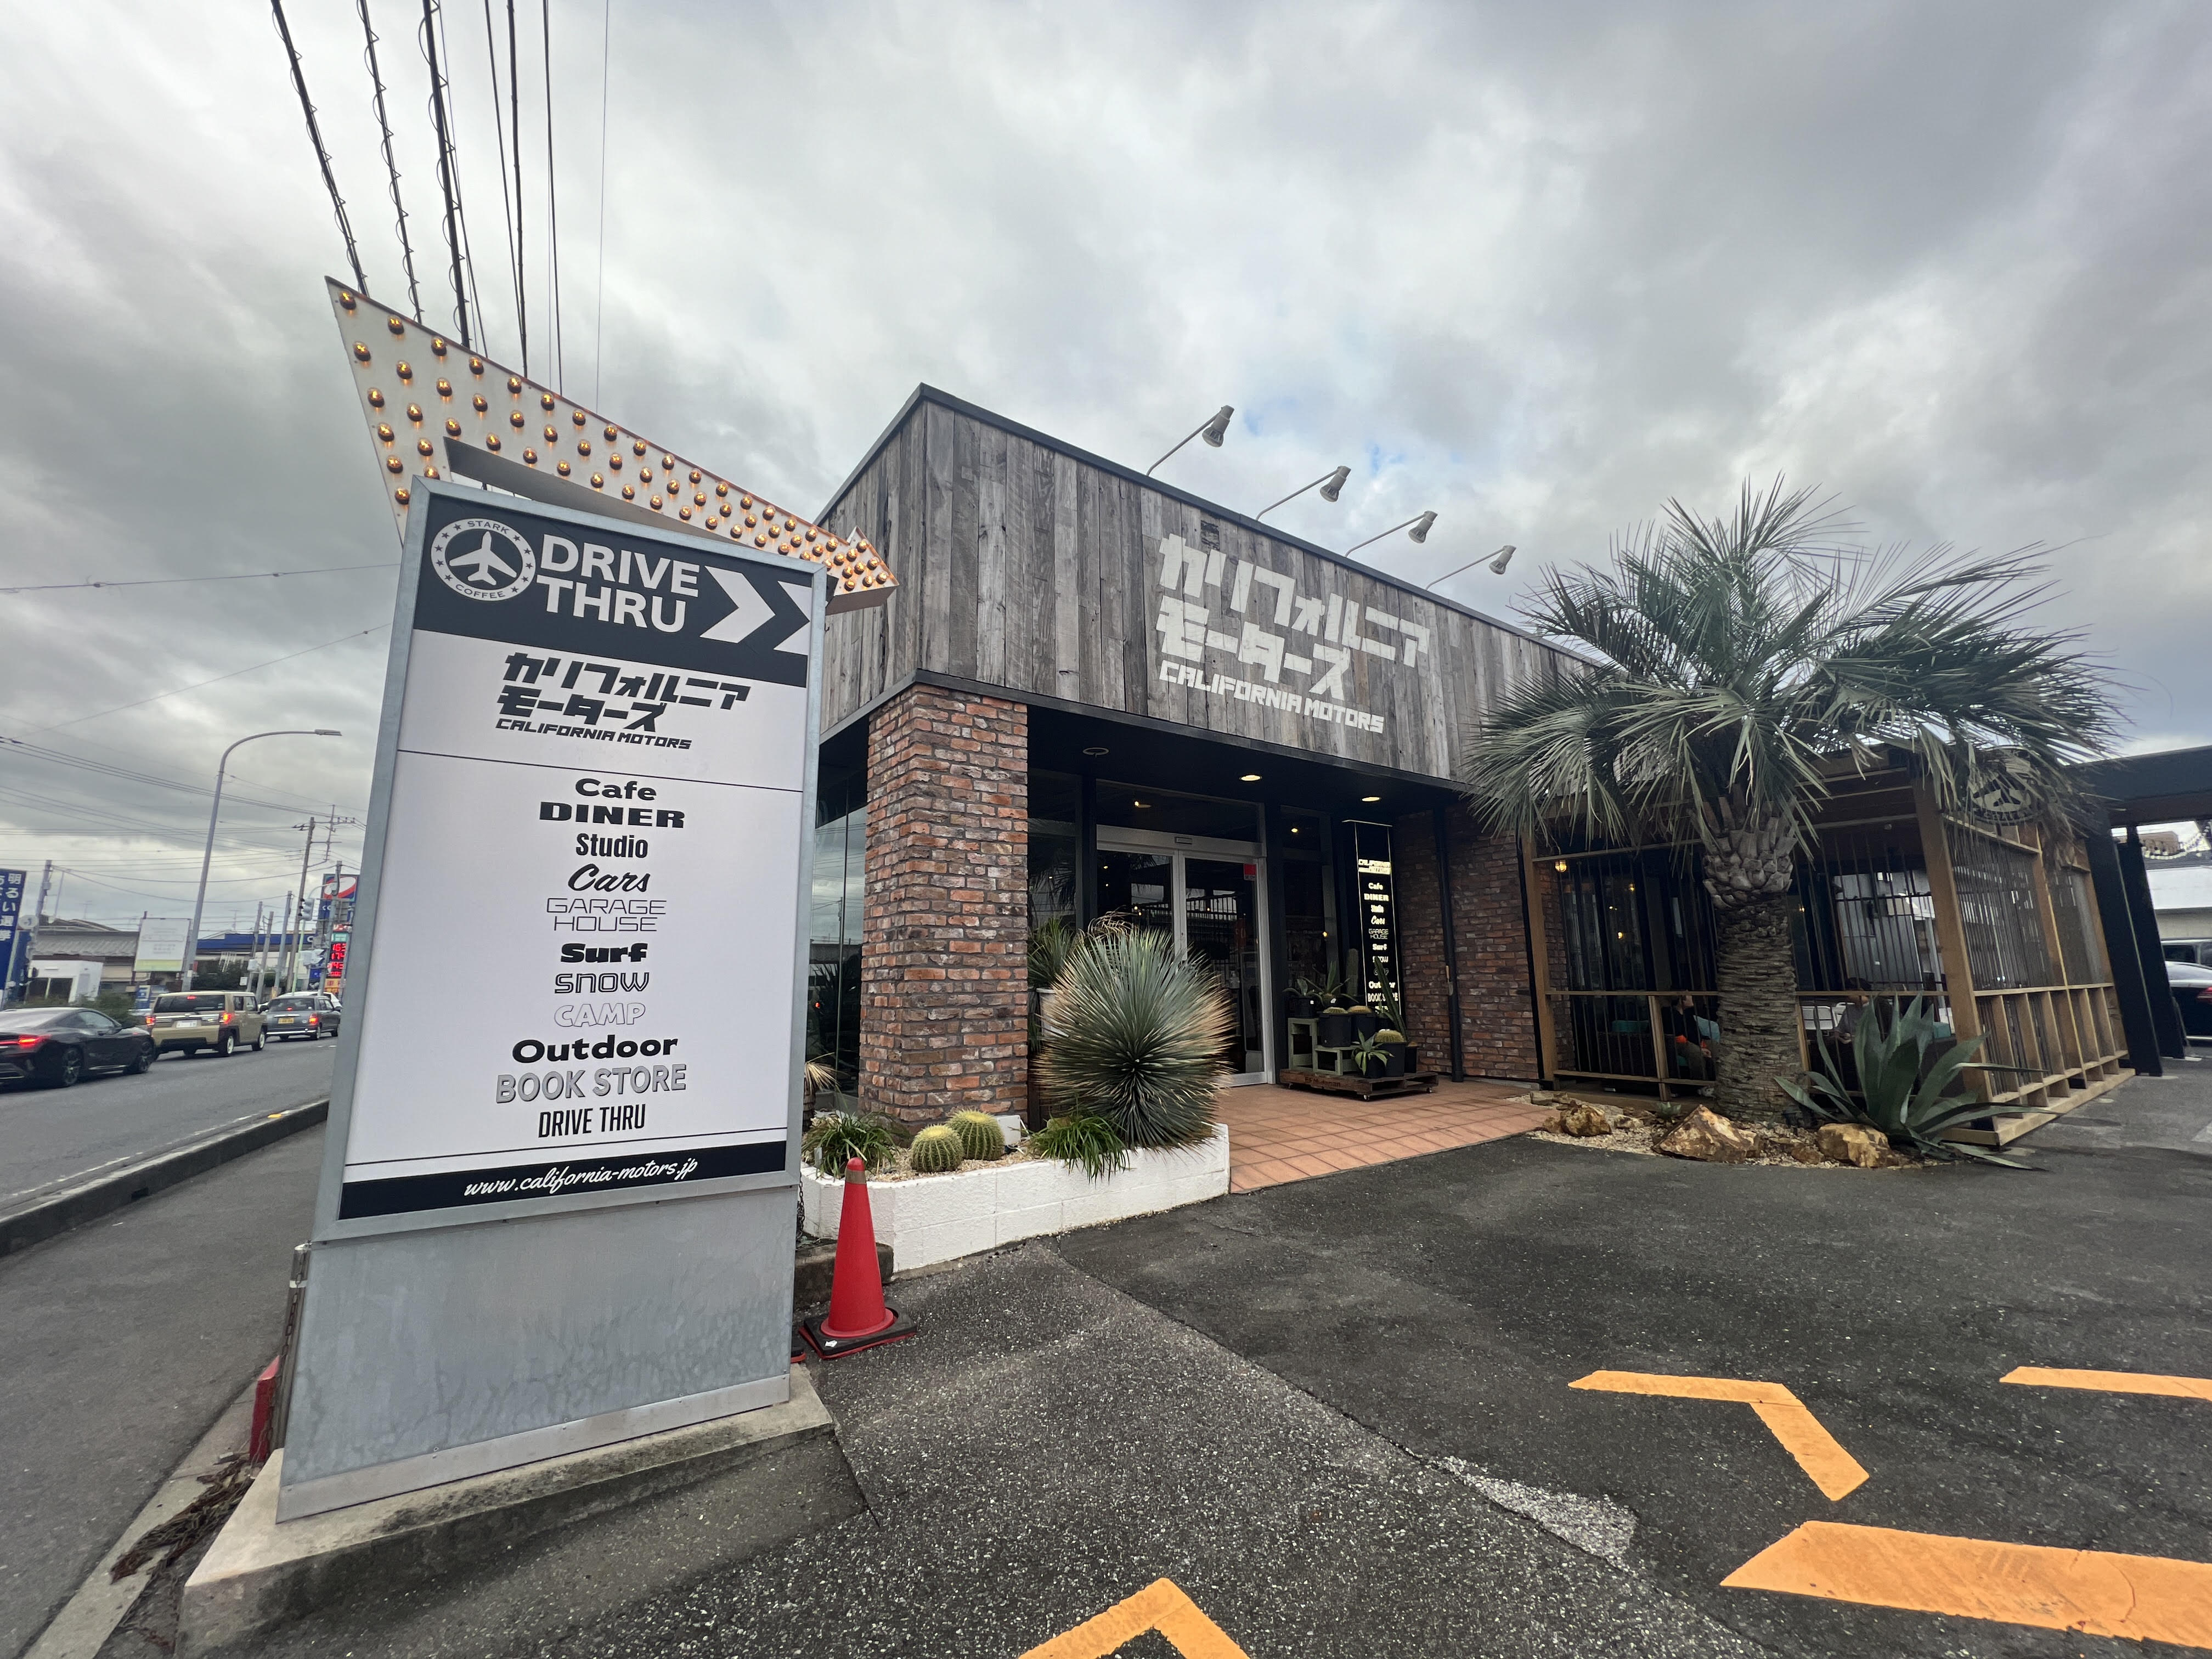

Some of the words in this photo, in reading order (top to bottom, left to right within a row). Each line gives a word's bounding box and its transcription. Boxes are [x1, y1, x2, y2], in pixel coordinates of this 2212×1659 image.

[467, 521, 509, 534] STARK
[540, 534, 700, 598] DRIVE
[456, 584, 506, 599] COFFEE
[536, 574, 686, 633] THRU
[1159, 533, 1430, 668] カリフォルニア
[1156, 595, 1351, 701] モーターズ
[504, 652, 751, 710] カリフォルニア
[497, 685, 667, 732] モーターズ
[1159, 659, 1302, 714] CALIFORNIA
[1304, 697, 1385, 734] MOTORS
[495, 719, 616, 741] CALIFORNIA
[618, 732, 693, 750] MOTORS
[575, 778, 657, 801] Cafe
[539, 802, 685, 828] DINER
[576, 833, 648, 859] Studio
[568, 864, 650, 893] Cars
[546, 898, 667, 915] GARAGE
[1364, 893, 1389, 901] DINER
[554, 916, 658, 932] HOUSE
[560, 943, 648, 963] Surf
[554, 1002, 646, 1028] CAMP
[512, 1034, 679, 1063] Outdoor
[495, 1069, 586, 1104] BOOK
[592, 1063, 687, 1097] STORE
[538, 1108, 594, 1138] DRIVE
[599, 1104, 646, 1132] THRU
[464, 1158, 698, 1196] www.california-motors.jp
